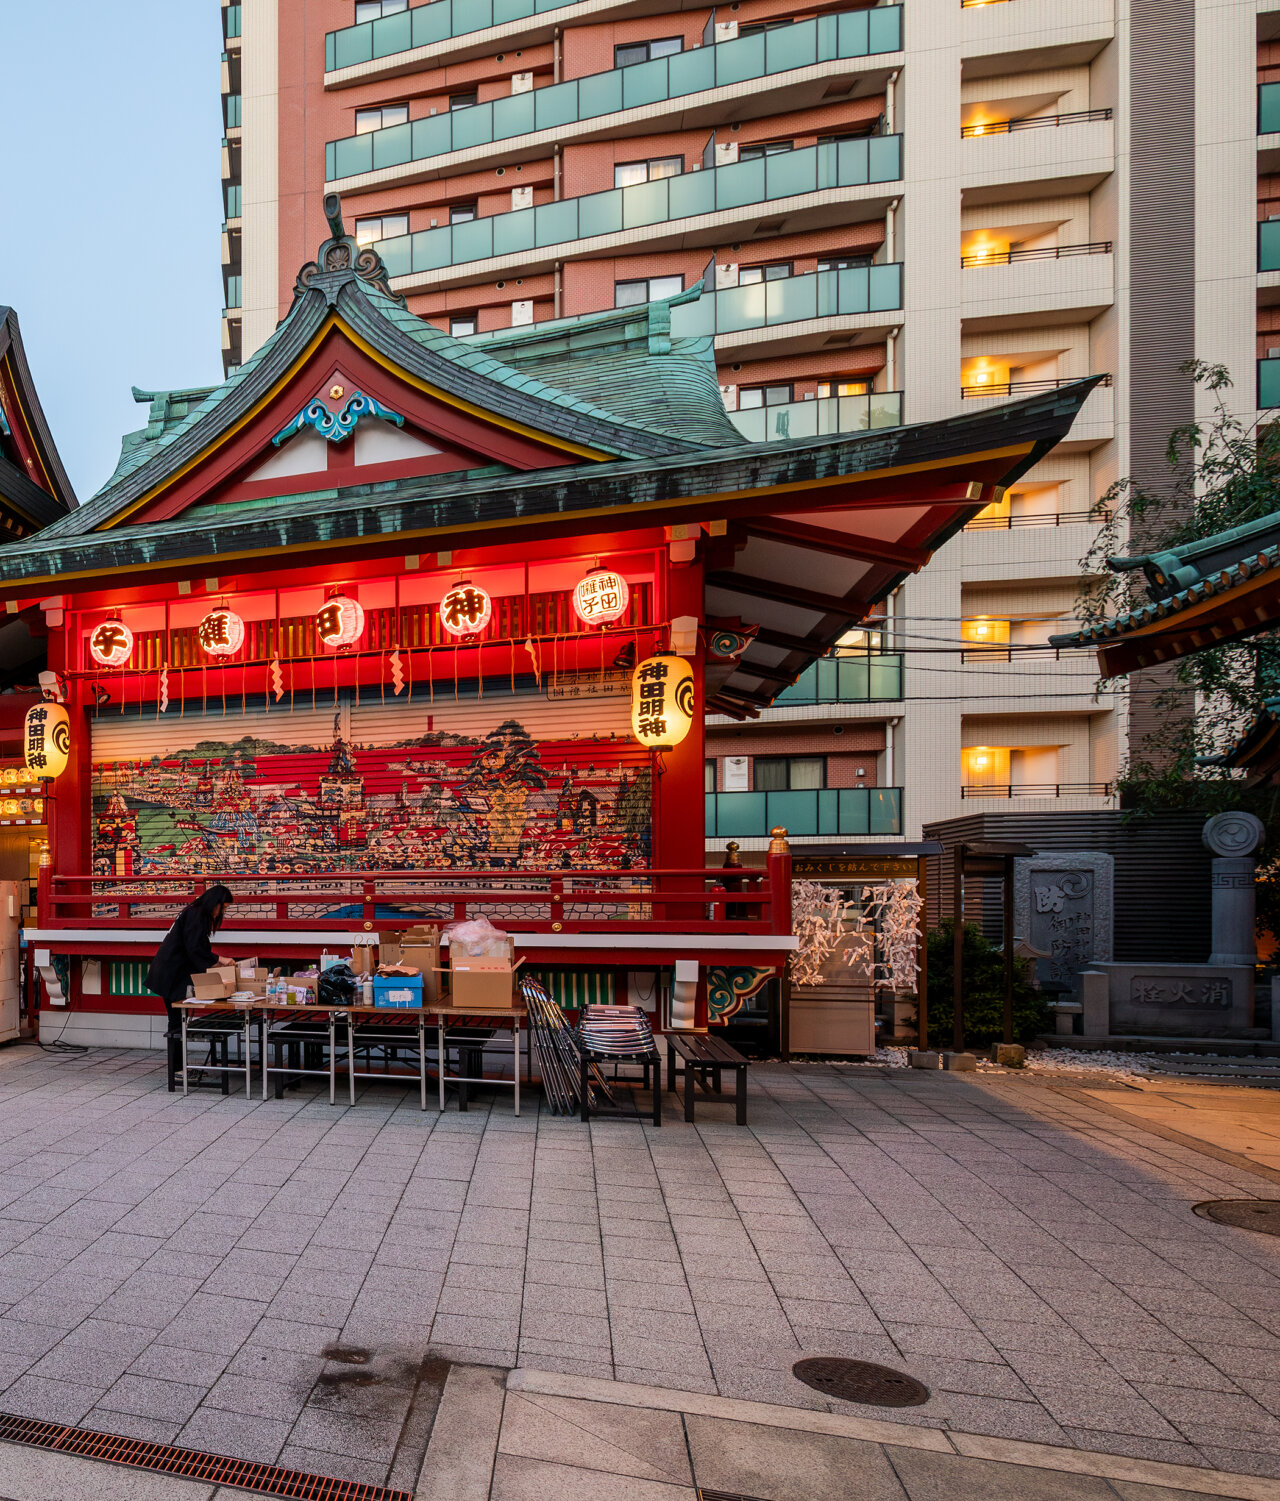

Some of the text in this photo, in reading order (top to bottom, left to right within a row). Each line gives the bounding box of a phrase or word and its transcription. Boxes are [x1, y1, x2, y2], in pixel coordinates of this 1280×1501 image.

[444, 587, 486, 628] 神
[637, 661, 669, 737] 神田明神
[27, 707, 48, 770] 神田明神
[794, 863, 913, 873] おみくじを結んで下さい
